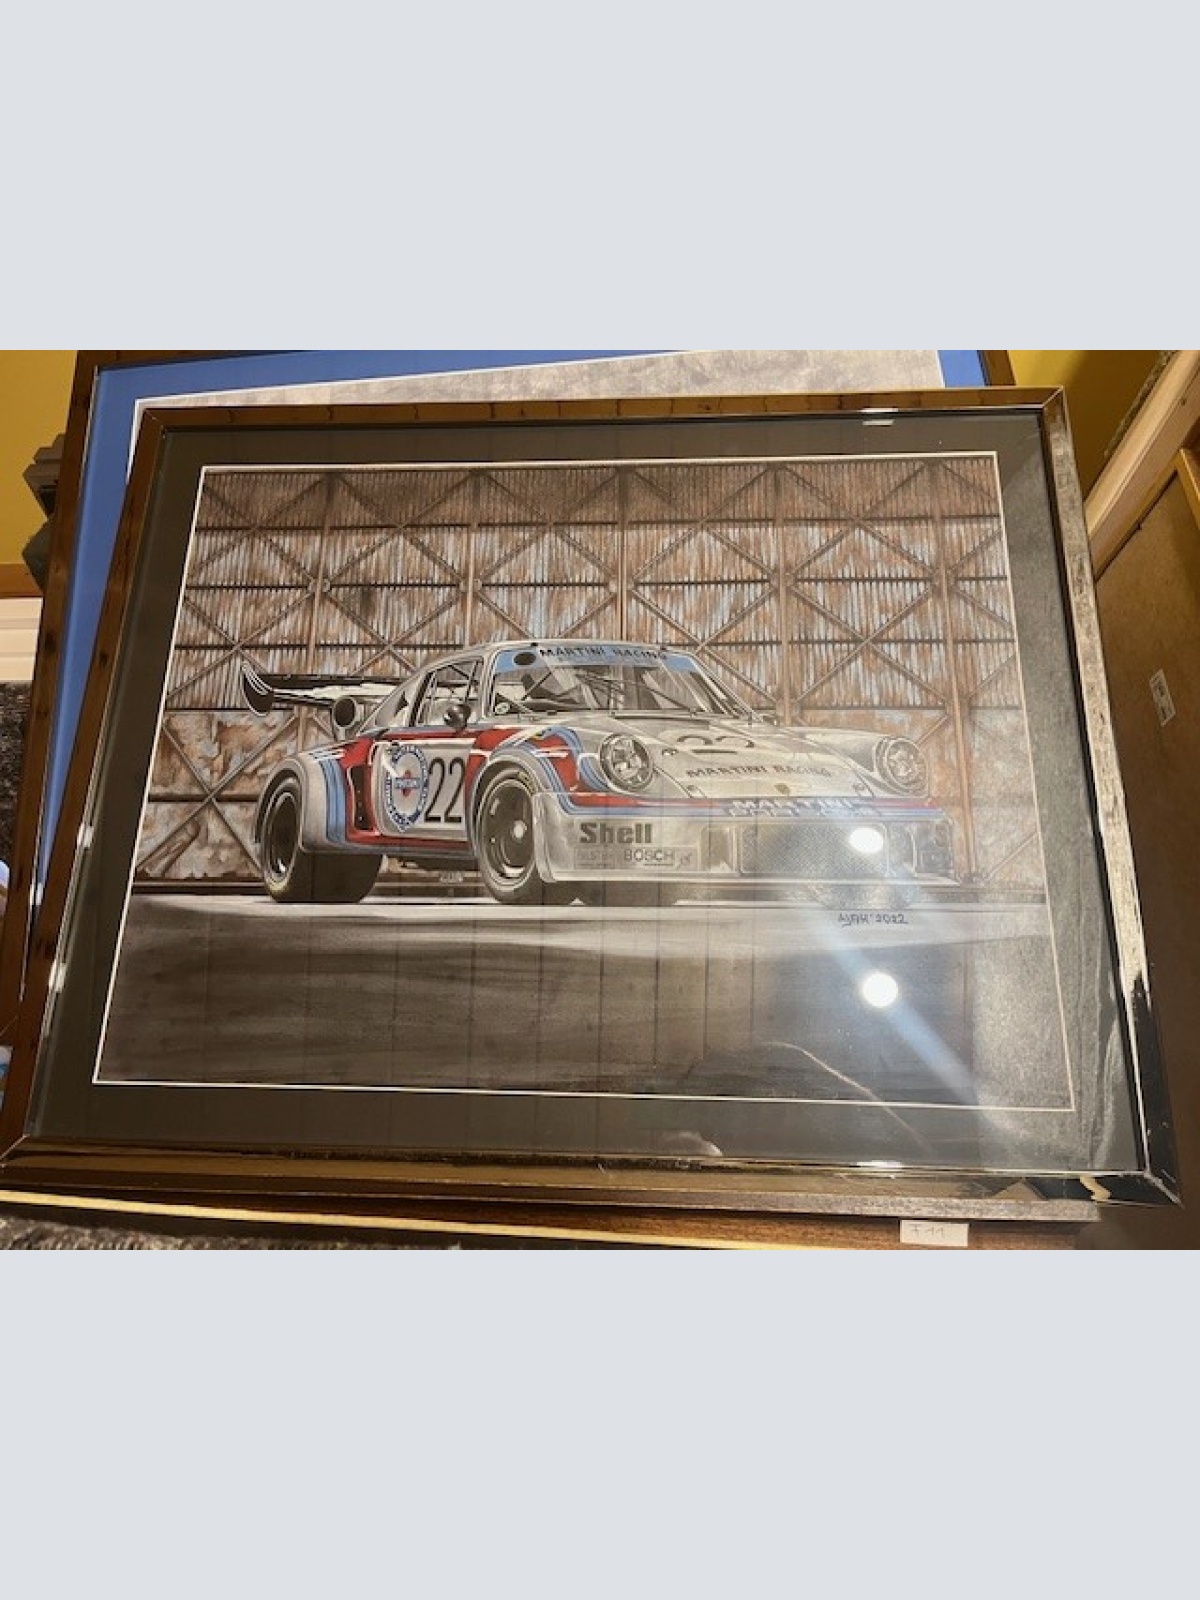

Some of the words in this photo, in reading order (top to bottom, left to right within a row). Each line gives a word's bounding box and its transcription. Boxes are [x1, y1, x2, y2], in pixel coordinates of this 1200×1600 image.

[685, 765, 769, 778] MARTINI
[423, 756, 466, 823] 22
[579, 821, 653, 845] Shell
[623, 848, 676, 862] BOSCH
